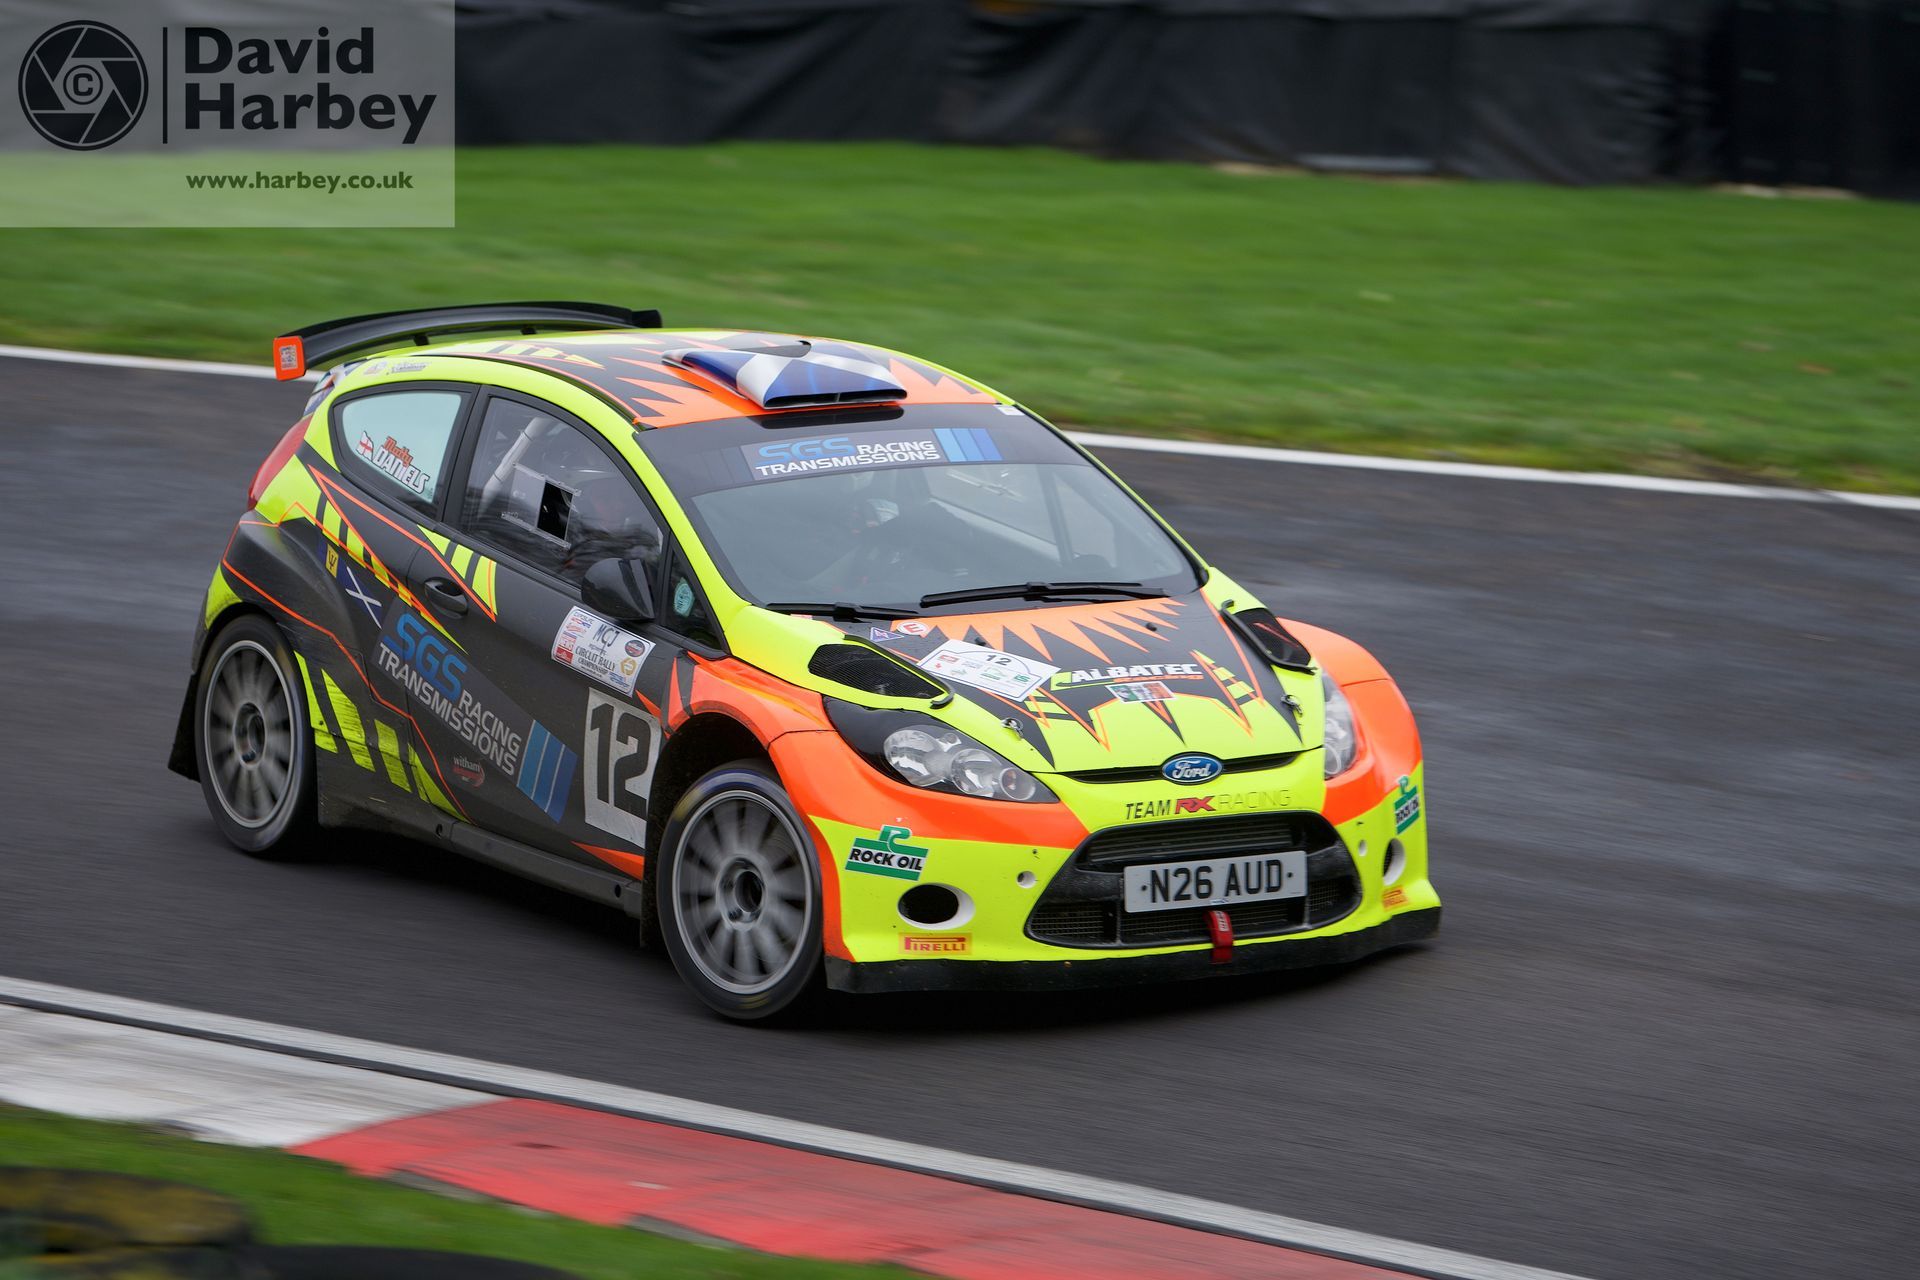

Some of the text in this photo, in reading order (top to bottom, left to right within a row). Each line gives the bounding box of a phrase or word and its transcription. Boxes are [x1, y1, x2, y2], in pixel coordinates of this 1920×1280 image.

[756, 450, 941, 476] TRANSMISSIONS
[758, 437, 935, 464] SGS RACING
[373, 445, 430, 494] DANIELS
[985, 654, 1012, 666] 12
[1071, 664, 1202, 682] ALBATEC
[383, 613, 522, 756] SGS RACING
[379, 642, 517, 776] TRANSMISSIONS
[590, 702, 651, 820] 12
[1172, 759, 1211, 778] Ford
[1126, 799, 1171, 820] TEAM
[1218, 790, 1291, 810] RACING
[850, 848, 923, 871] ROCK OIL
[1151, 859, 1282, 903] N26 AUD
[904, 936, 966, 951] PIRELLI
